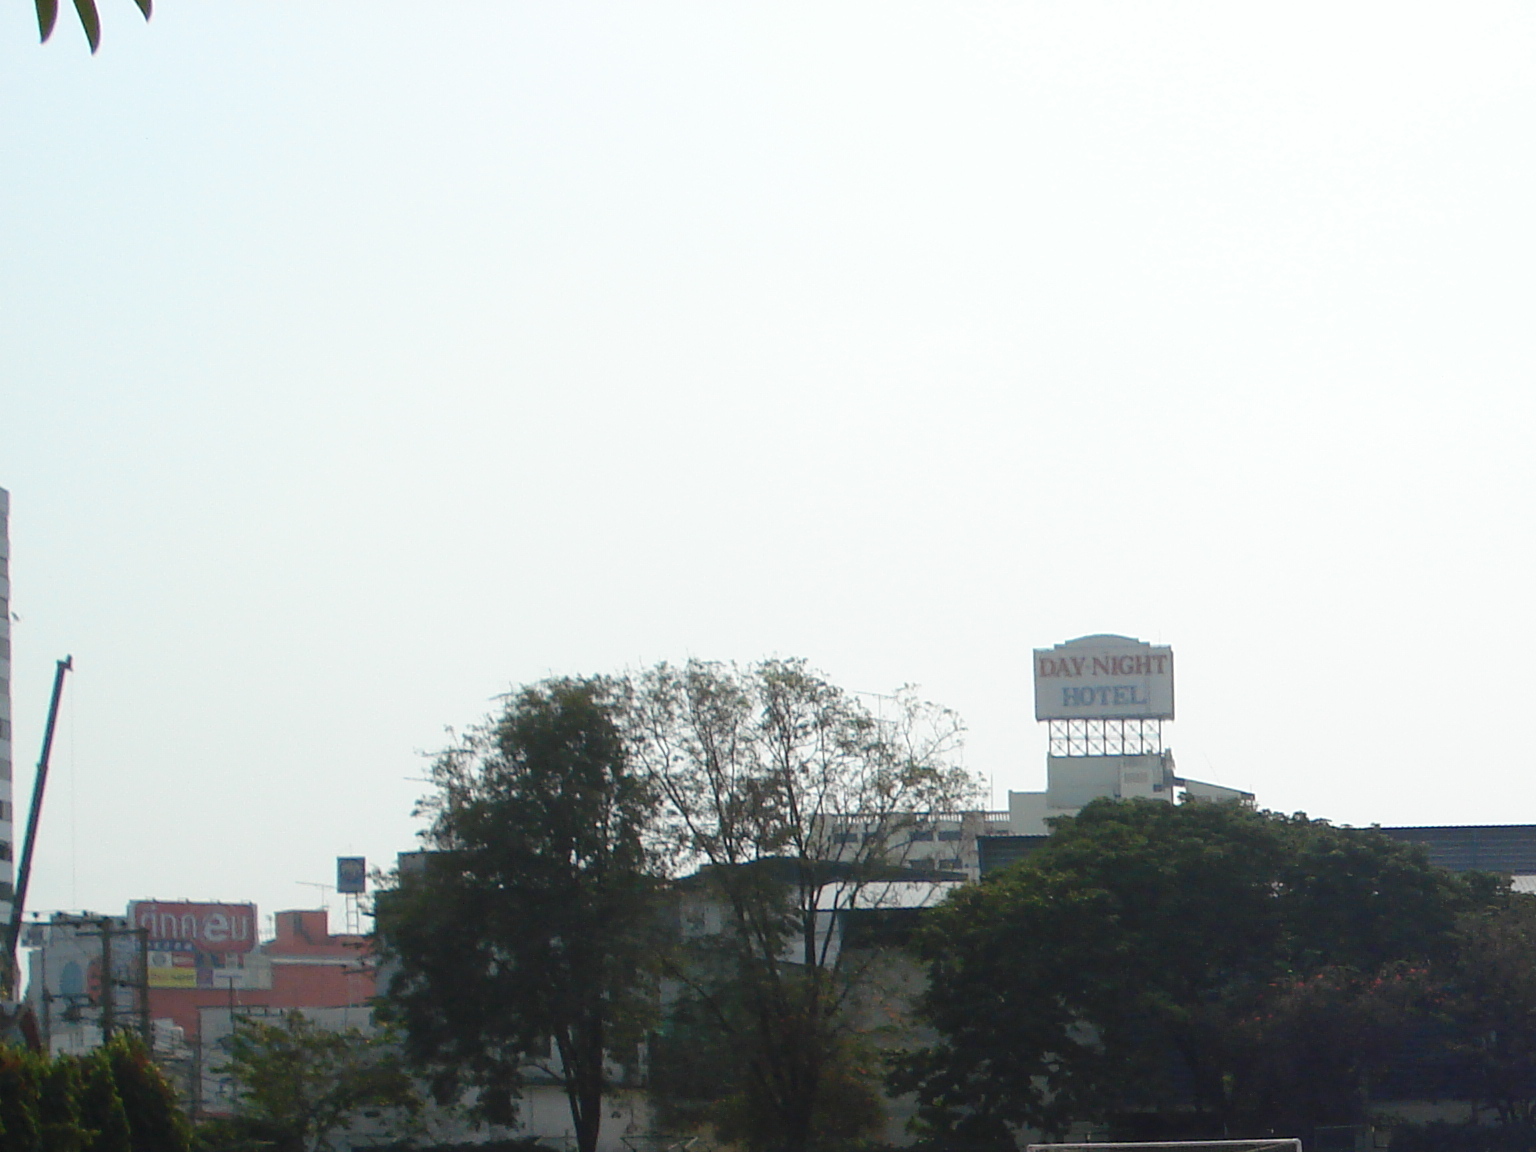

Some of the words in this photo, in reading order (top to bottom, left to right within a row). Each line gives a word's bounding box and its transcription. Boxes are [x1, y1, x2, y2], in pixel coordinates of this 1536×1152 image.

[1039, 656, 1085, 677] DAY
[1092, 654, 1167, 676] NIGHT
[1062, 685, 1147, 706] HOTEL
